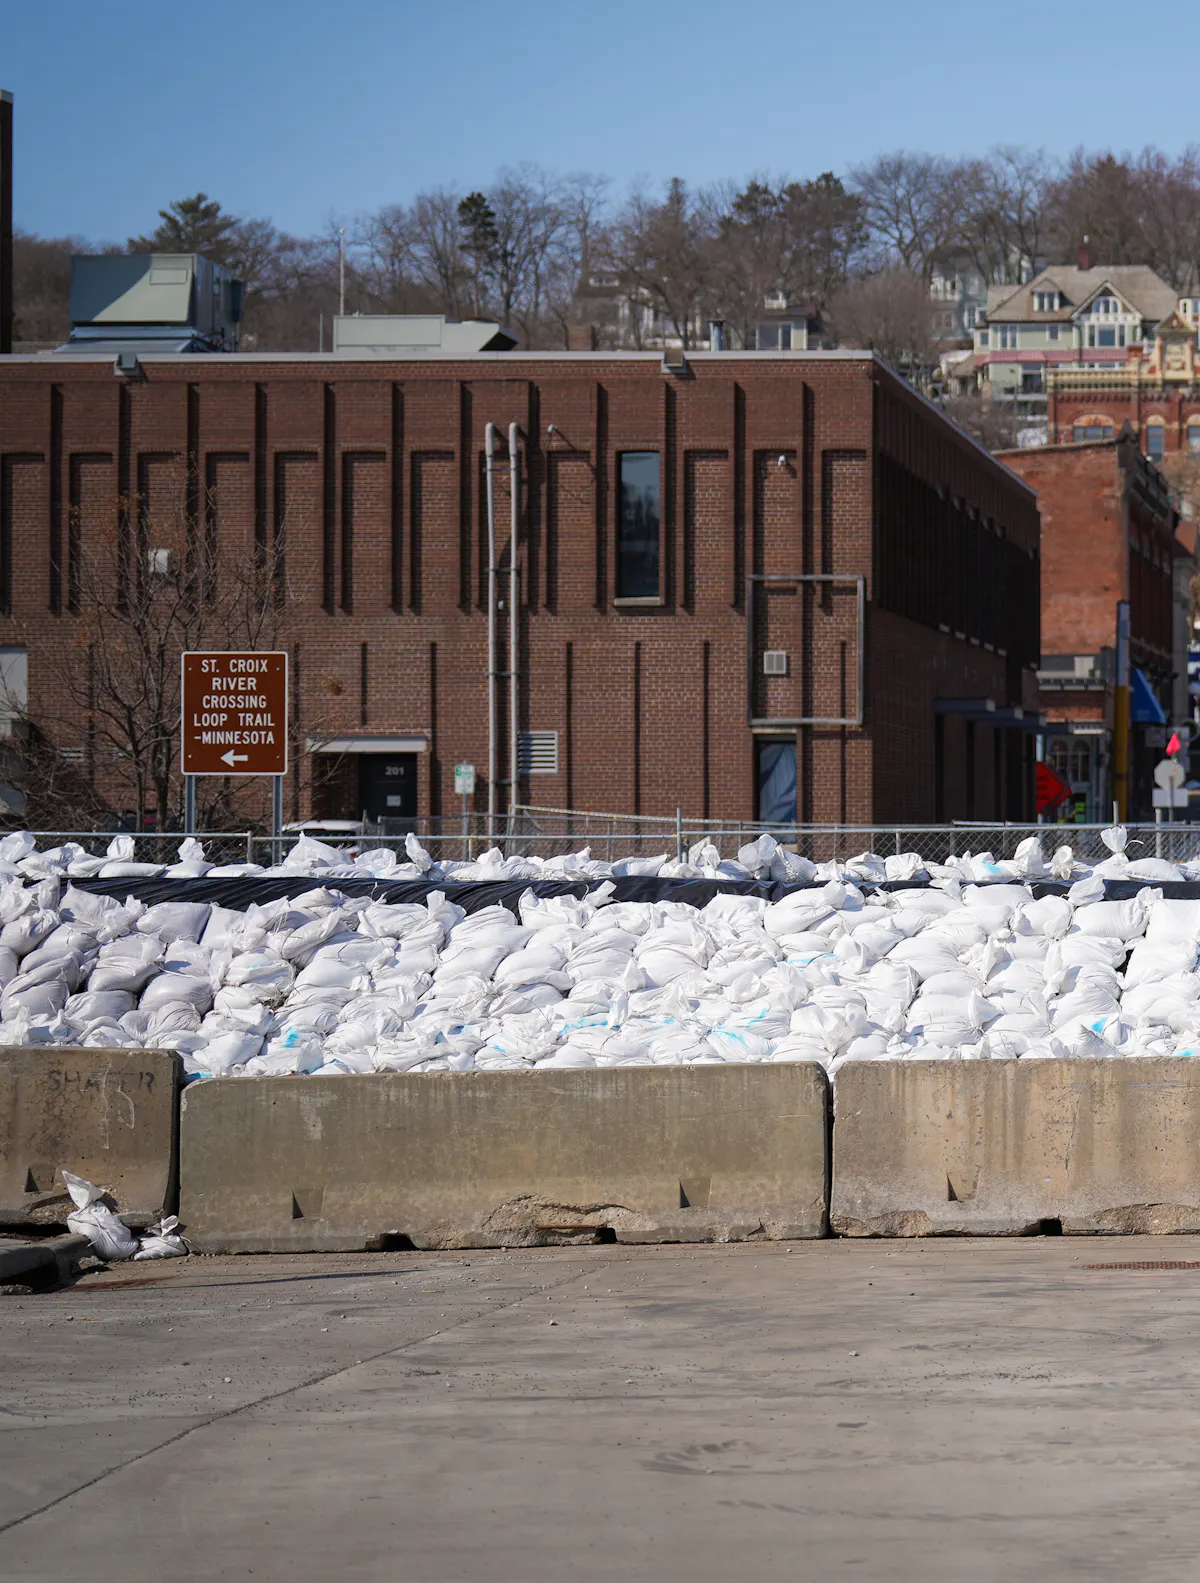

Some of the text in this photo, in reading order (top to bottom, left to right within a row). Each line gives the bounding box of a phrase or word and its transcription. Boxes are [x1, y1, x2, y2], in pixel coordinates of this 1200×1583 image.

[201, 659, 269, 673] ST. CROIX
[211, 677, 257, 690] RIVER
[202, 695, 267, 709] CROSSING
[193, 713, 275, 727] LOOP TRAIL
[385, 766, 405, 776] 201
